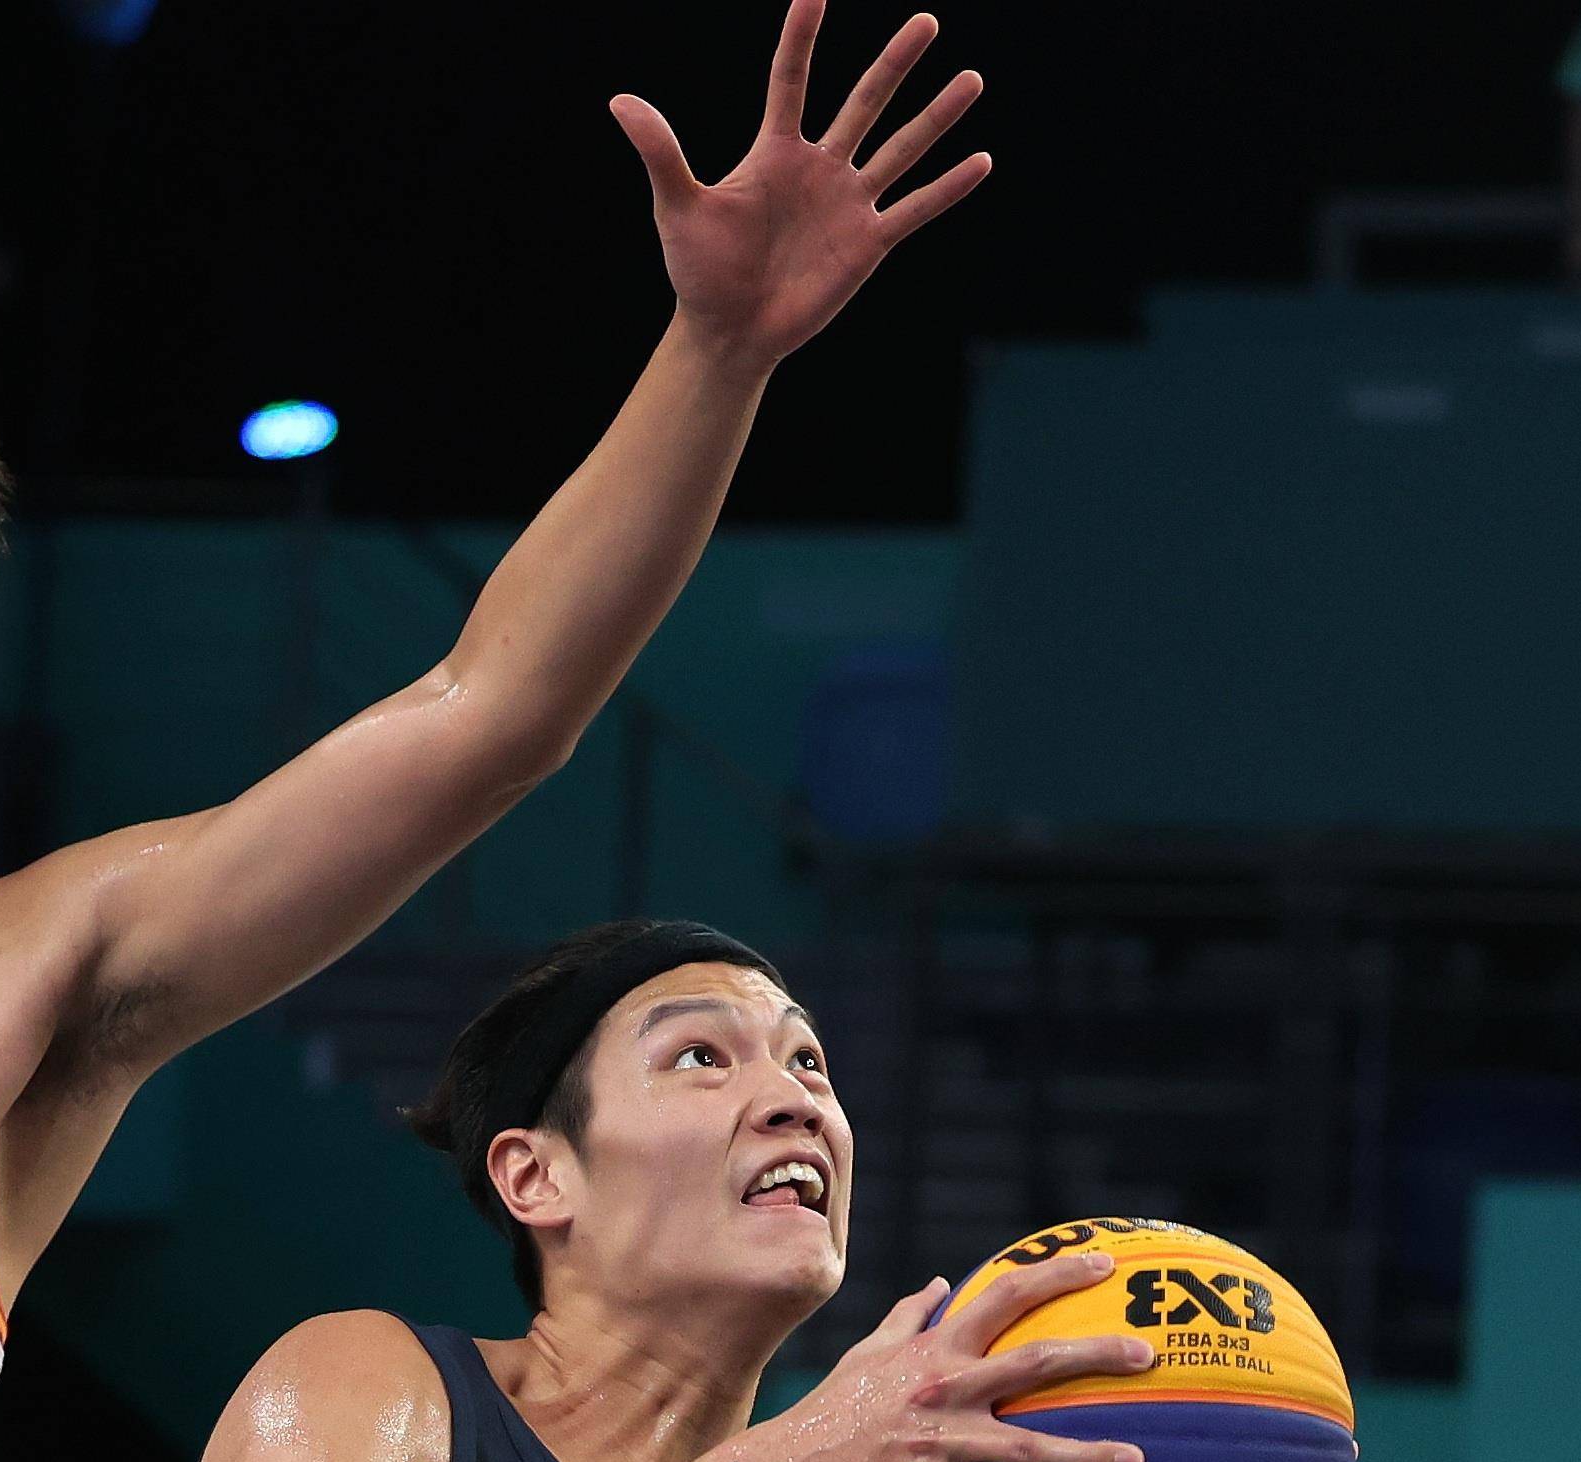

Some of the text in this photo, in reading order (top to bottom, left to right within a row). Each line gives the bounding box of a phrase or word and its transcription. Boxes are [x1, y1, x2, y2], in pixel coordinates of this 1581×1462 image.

[1166, 1332, 1250, 1351] FIBA 3x3
[1152, 1353, 1275, 1375] FFICIAL BALL
